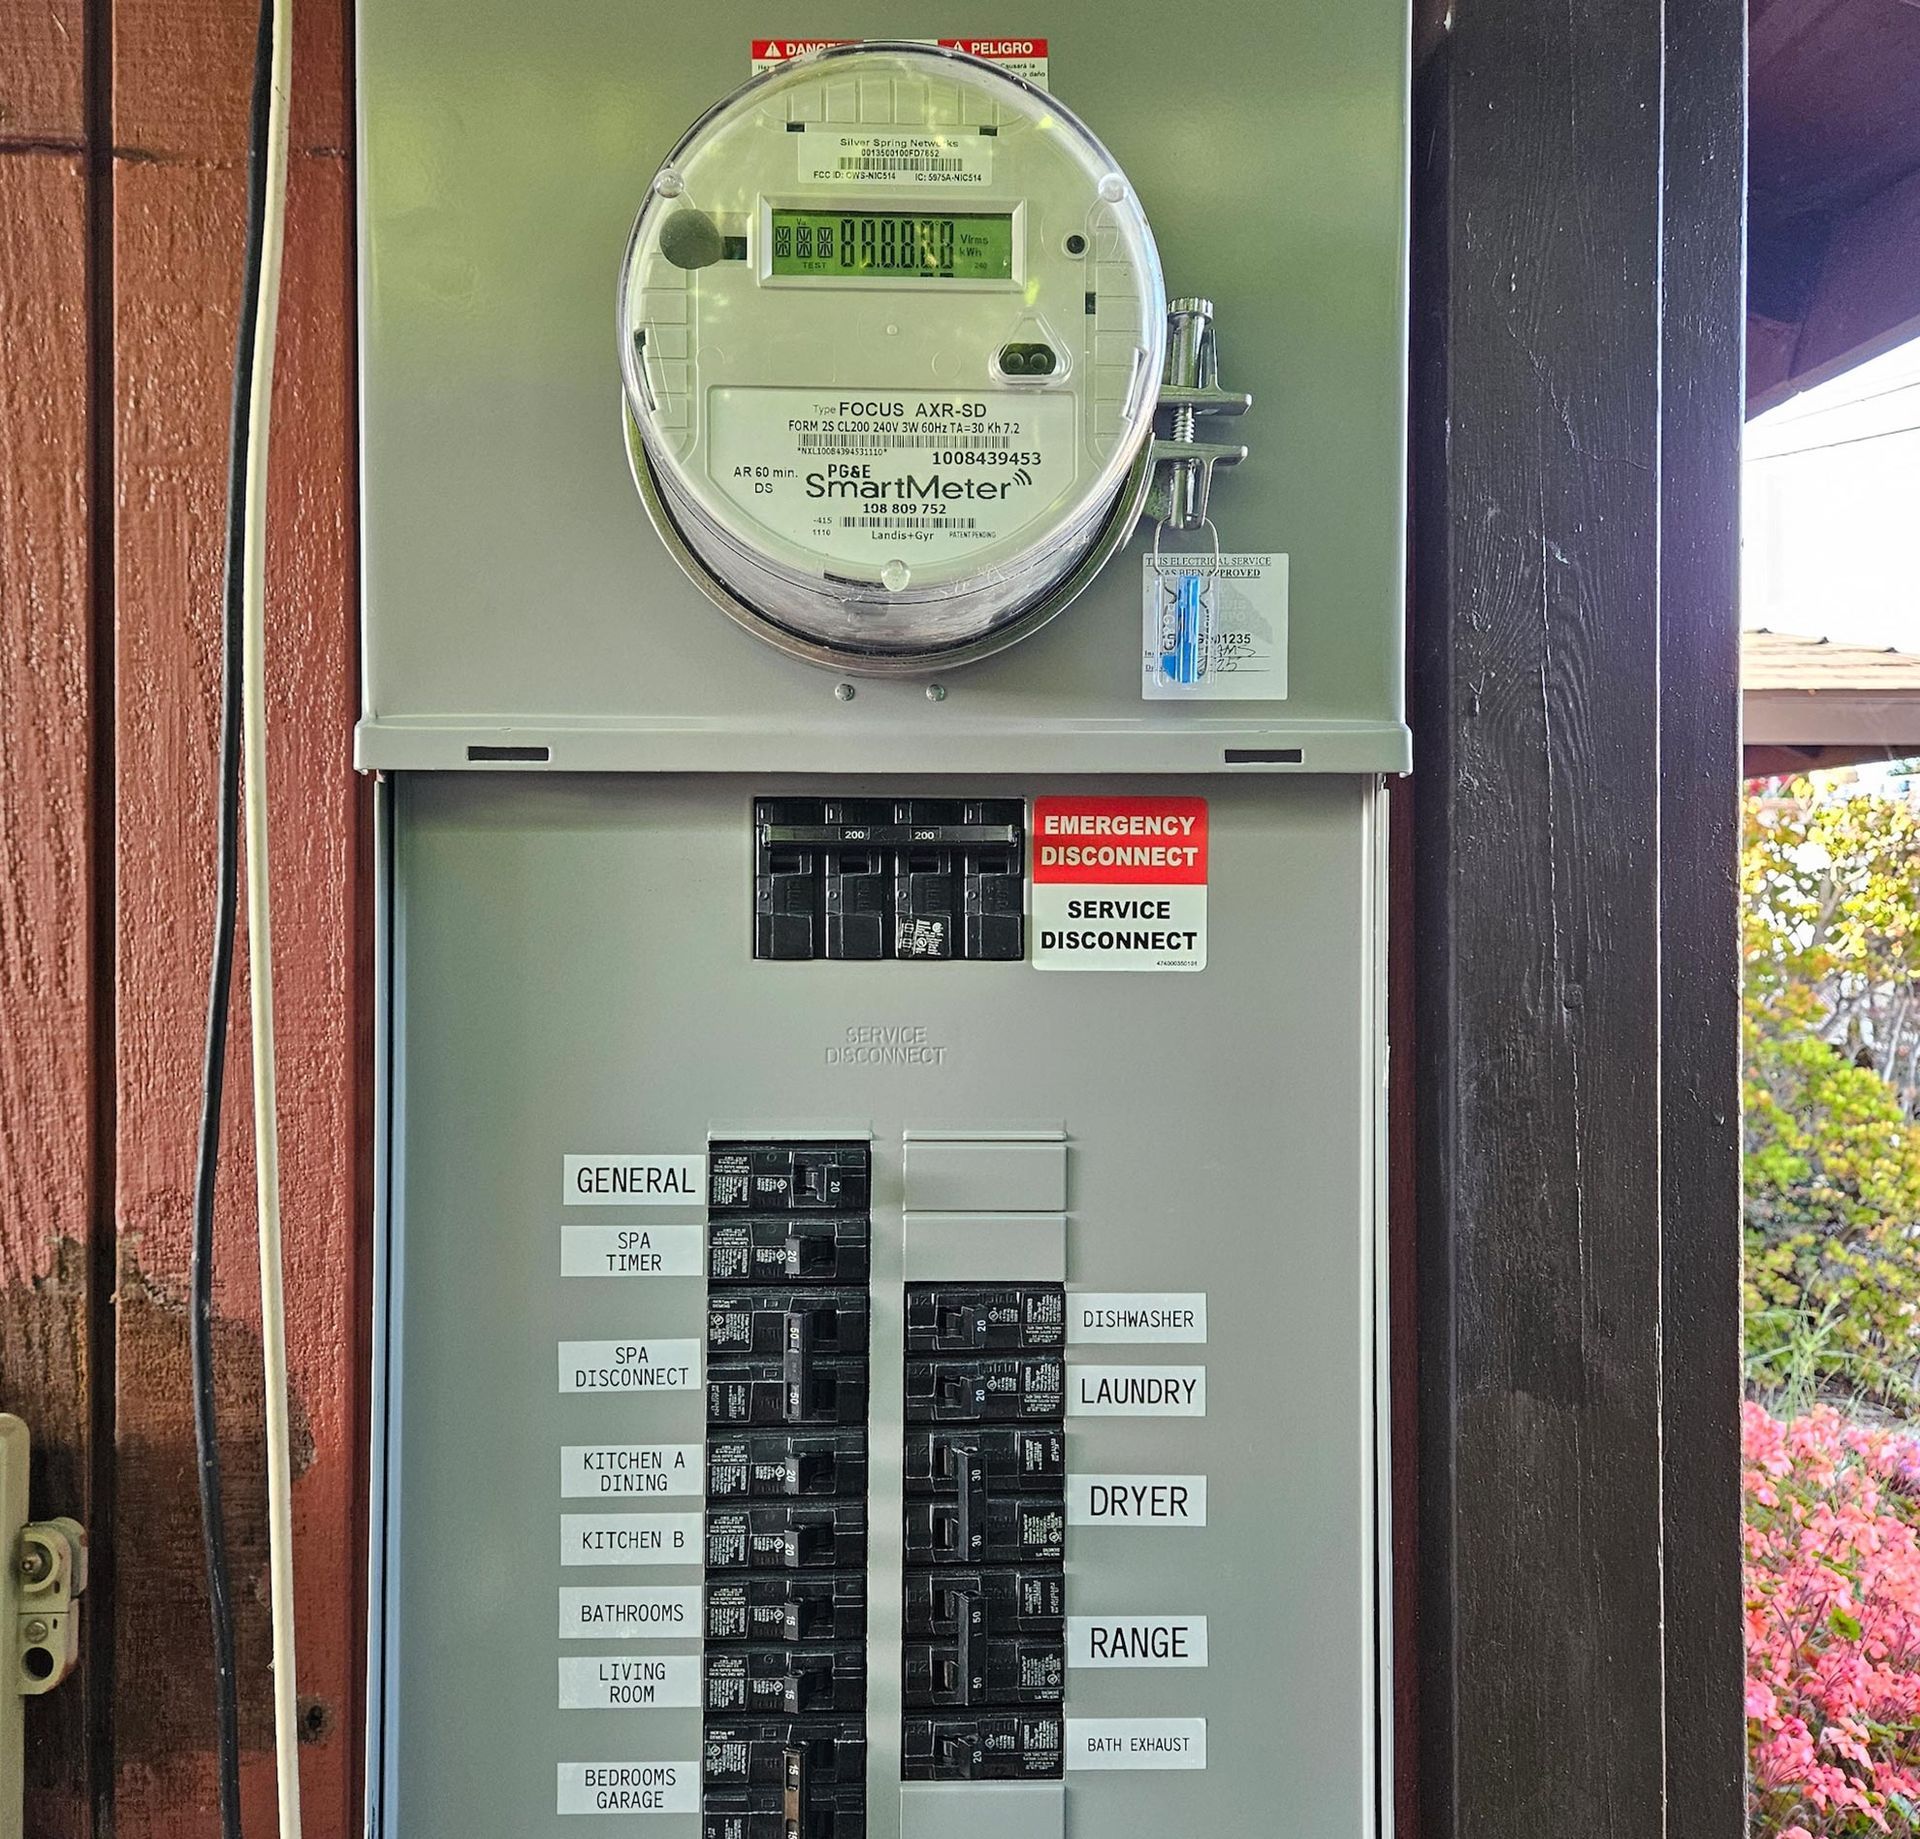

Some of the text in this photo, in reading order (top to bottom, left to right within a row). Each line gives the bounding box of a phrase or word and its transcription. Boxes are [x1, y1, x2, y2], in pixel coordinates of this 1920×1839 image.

[971, 42, 1033, 54] PELIGRO
[840, 138, 869, 146] Silver
[873, 138, 907, 148] Spring
[814, 170, 830, 179] FCC
[814, 402, 987, 418] Type FOCUS AXR-SD
[788, 421, 1020, 434] FORM 2S CL200 240V 3W 60Hz TA=30 Kh 7.2
[932, 451, 1041, 466] 1008439453
[733, 466, 798, 478] AR 60 min.
[828, 464, 870, 478] PG&E
[754, 482, 774, 494] DS
[805, 473, 1011, 500] SmartMeter
[863, 503, 946, 514] 108 809 752
[872, 530, 934, 541] Landis+Gyr
[1146, 557, 1168, 565] TIS
[1231, 556, 1271, 566] SERVICE
[1044, 815, 1196, 836] EMERGENCY
[844, 830, 866, 839] 200
[914, 832, 935, 840] 200
[1041, 846, 1199, 867] DISCONNECT
[1067, 900, 1171, 920] SERVICE
[1041, 931, 1198, 952] DISCONNECT
[846, 1026, 928, 1044] SERVICE
[825, 1046, 946, 1065] DISCONNECT
[577, 1168, 696, 1193] GENERAL
[830, 1180, 841, 1194] 20
[618, 1232, 650, 1249] SPA
[606, 1254, 662, 1272] TIMER
[787, 1250, 797, 1263] 20
[977, 1319, 986, 1332] 20
[1084, 1310, 1194, 1328] DISHWASHER
[790, 1326, 800, 1340] 50
[616, 1346, 648, 1364] SPA
[576, 1368, 689, 1387] DISCONNECT
[976, 1389, 985, 1402] 20
[1081, 1378, 1197, 1404] LAUNDRY
[790, 1392, 799, 1405] 50
[584, 1452, 686, 1470] KITCHEN A
[786, 1469, 796, 1483] 20
[972, 1468, 982, 1482] 30
[600, 1474, 668, 1492] DINING
[1090, 1486, 1188, 1516] DRYER
[582, 1531, 684, 1549] KITCHEN B
[972, 1535, 982, 1548] 30
[785, 1542, 795, 1557] 20
[581, 1604, 684, 1622] BATHROOMS
[972, 1610, 982, 1624] 50
[786, 1616, 796, 1626] 15
[1090, 1627, 1188, 1658] RANGE
[599, 1663, 666, 1681] LIVING
[973, 1676, 982, 1689] 50
[610, 1686, 654, 1703] ROOM
[785, 1689, 795, 1700] 15
[1088, 1738, 1190, 1752] BATH EXHAUST
[973, 1750, 982, 1763] 20
[585, 1768, 676, 1786] BEDROOMS
[789, 1764, 799, 1776] 15
[597, 1791, 664, 1809] GARAGE
